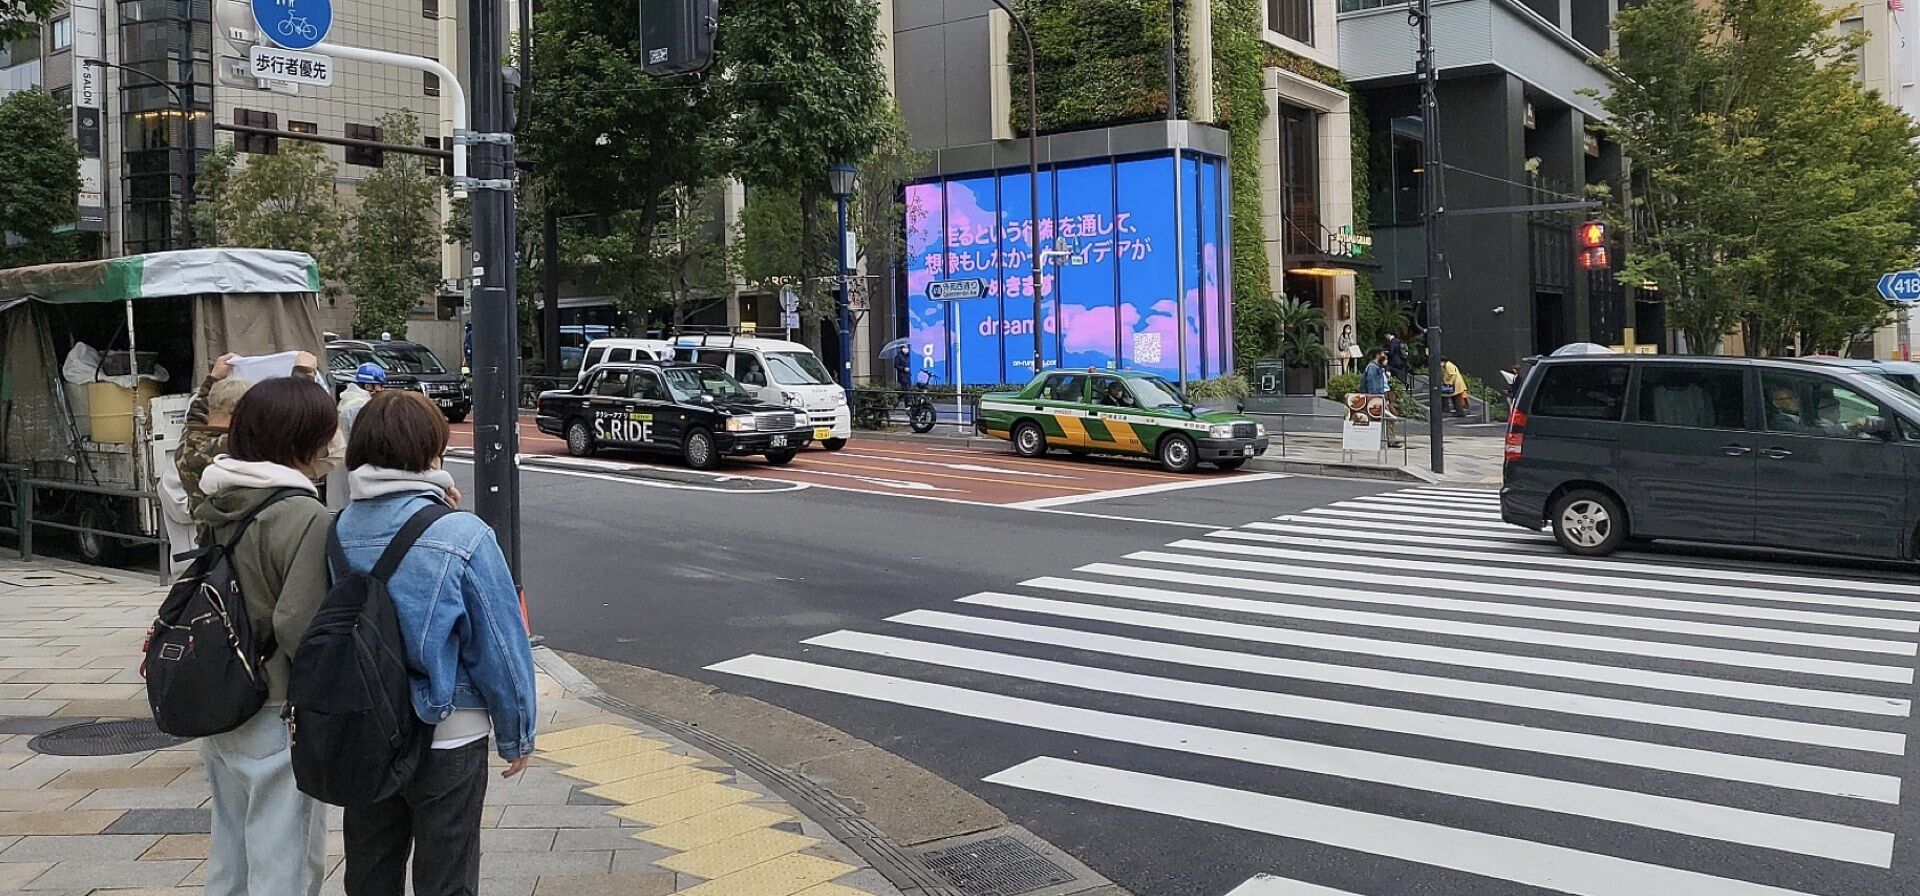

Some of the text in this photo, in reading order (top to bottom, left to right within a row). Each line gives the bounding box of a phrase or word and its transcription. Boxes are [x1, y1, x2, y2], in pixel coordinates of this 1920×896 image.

[256, 54, 326, 80] 歩行者優先
[83, 73, 92, 105] SALON
[1894, 278, 1920, 293] 418
